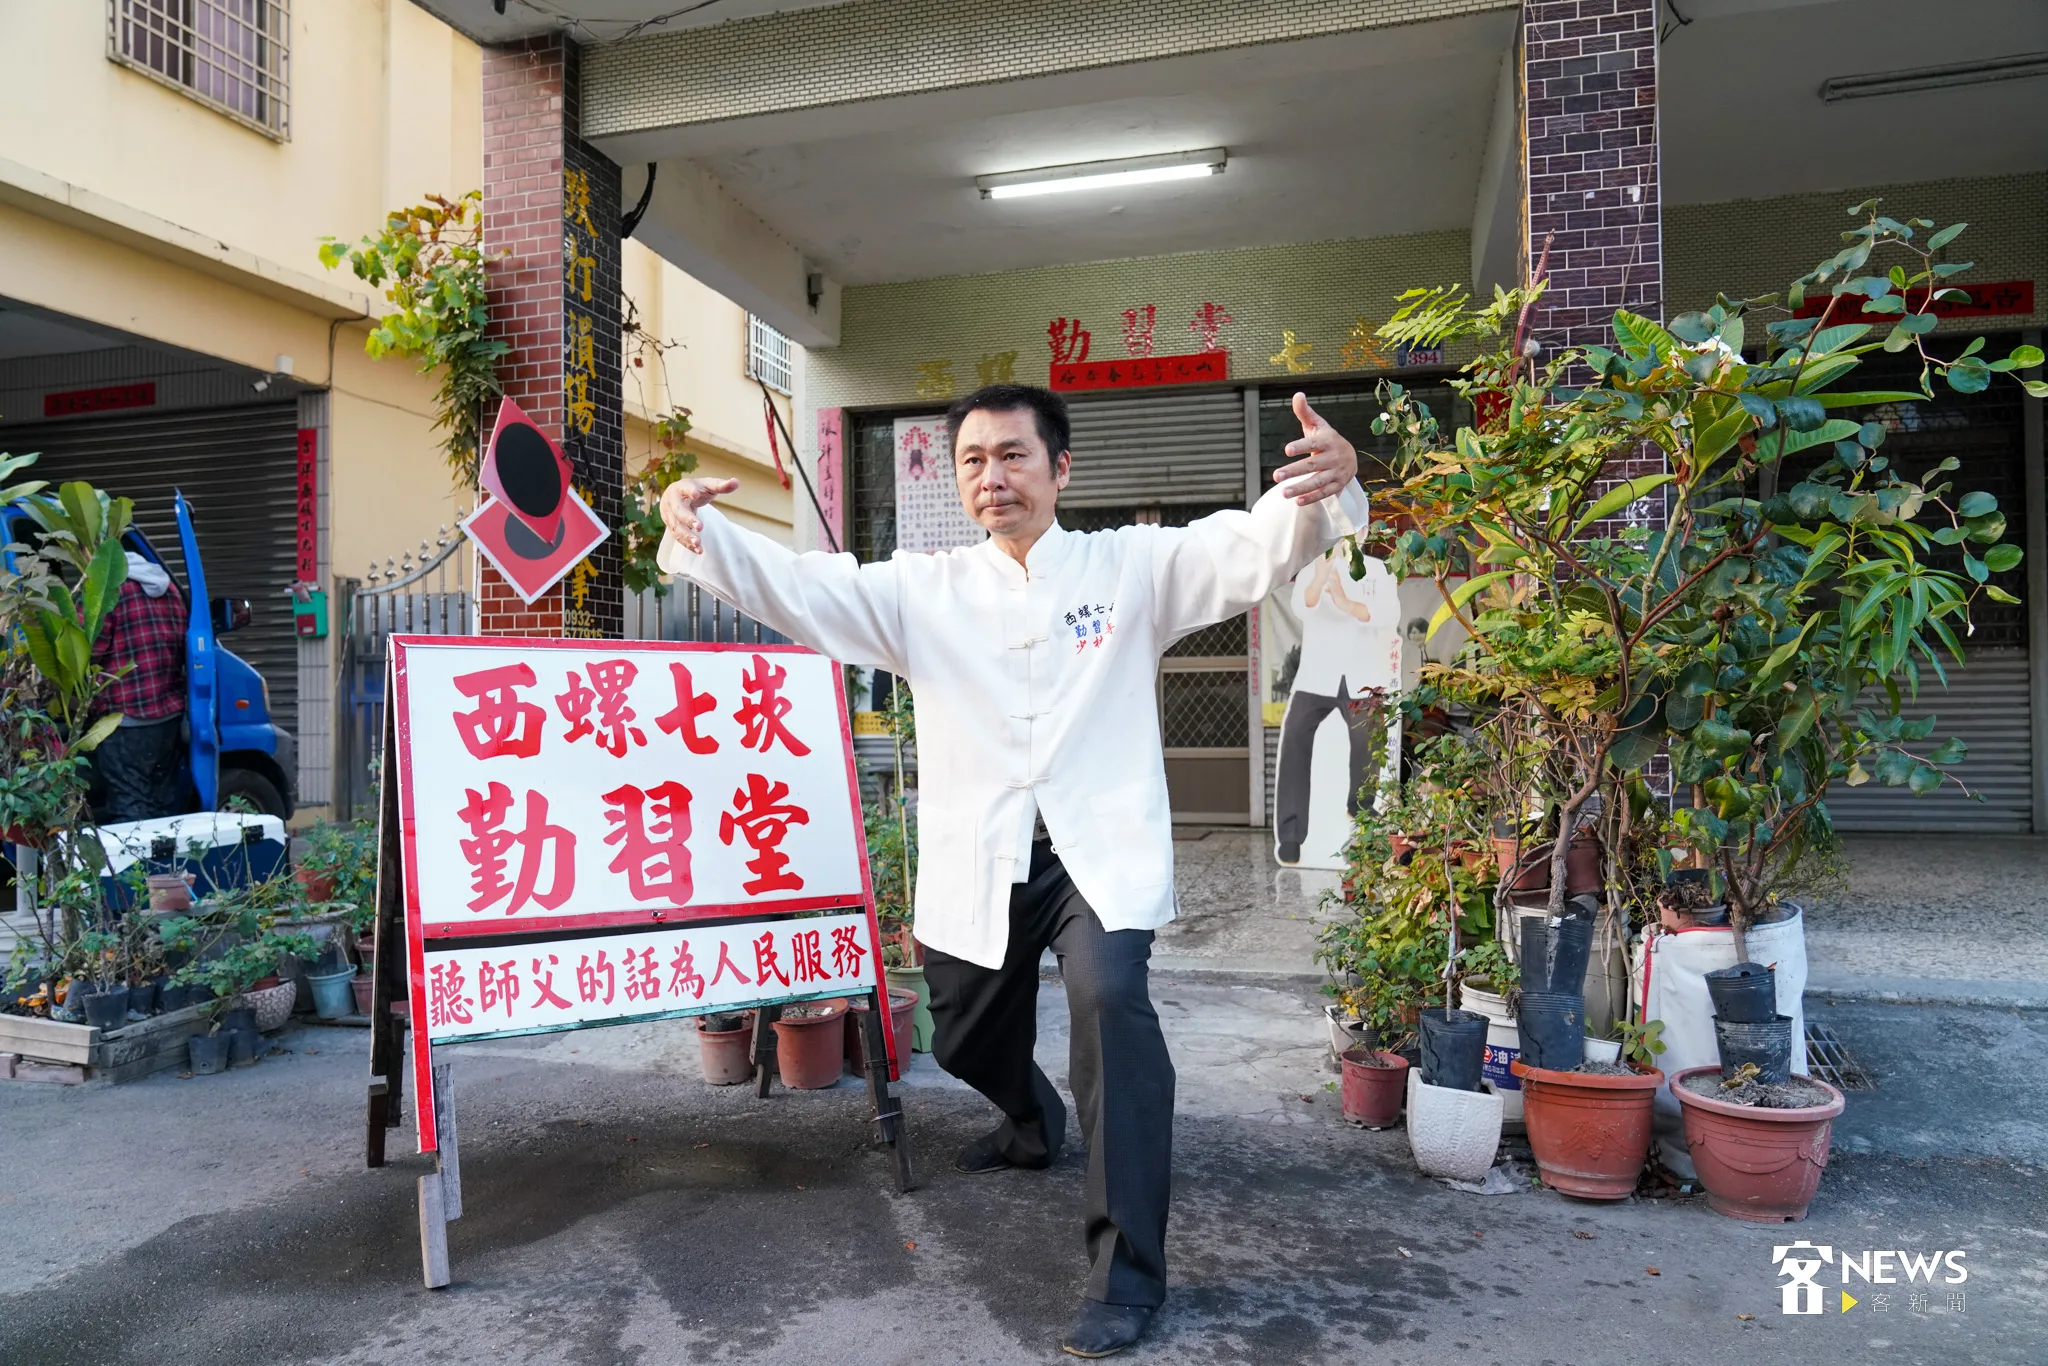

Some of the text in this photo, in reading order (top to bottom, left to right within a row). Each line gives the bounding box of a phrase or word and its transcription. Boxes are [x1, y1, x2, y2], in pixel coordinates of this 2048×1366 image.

[1407, 351, 1438, 366] 394
[564, 608, 595, 627] 0932-
[1075, 616, 1111, 638] 勤習
[453, 653, 811, 760] 西螺七崁
[456, 773, 810, 915] 勤習堂
[429, 923, 868, 1028] 聽師父的話為人民服務
